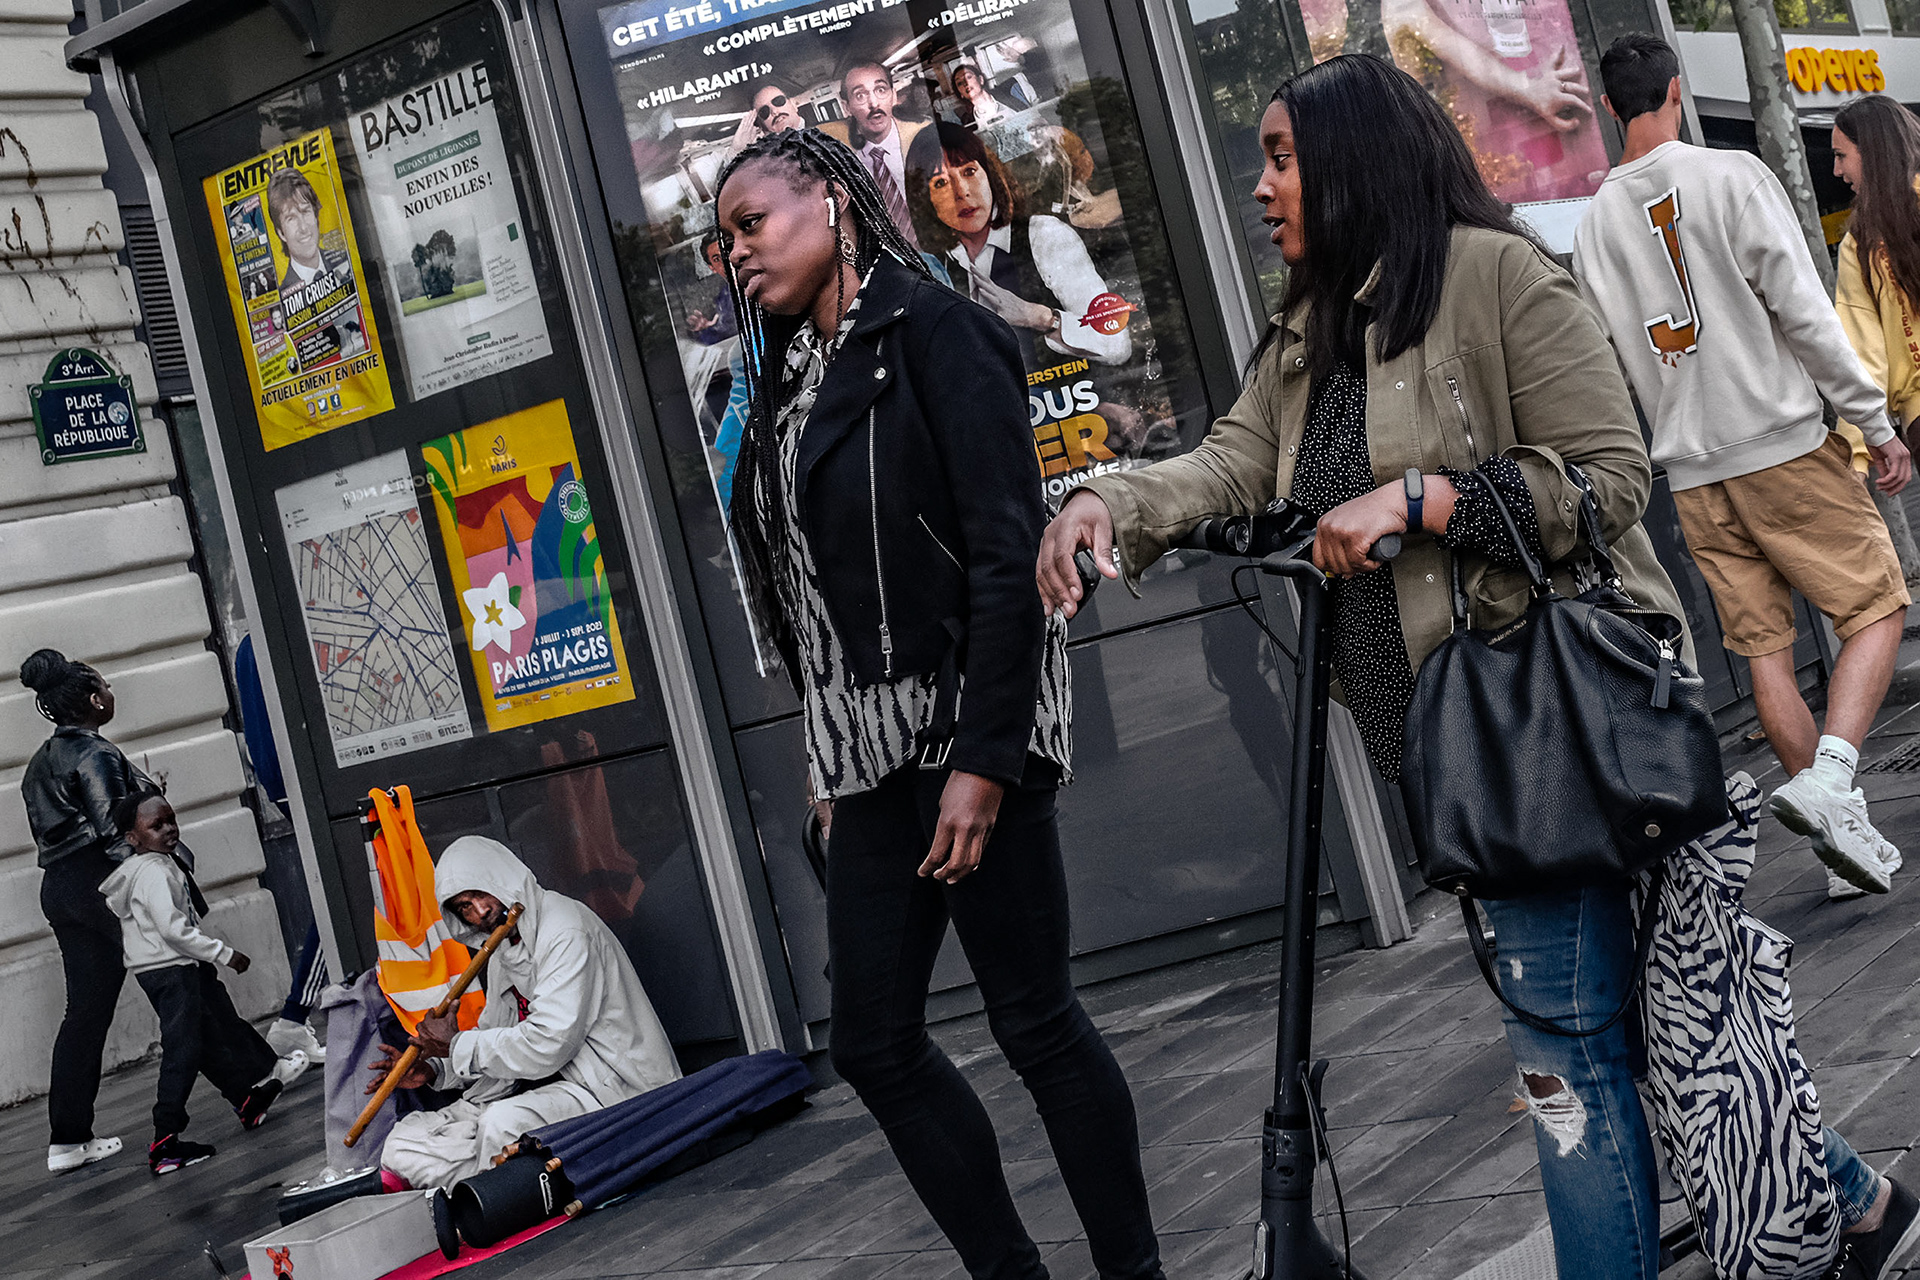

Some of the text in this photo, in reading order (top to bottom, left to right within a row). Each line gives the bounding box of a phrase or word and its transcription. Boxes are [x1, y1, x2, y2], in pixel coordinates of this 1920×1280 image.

[612, 16, 660, 46] CET
[665, 0, 721, 32] ÉTÉ,
[819, 20, 852, 34] NUMÉRO
[1002, 10, 1014, 18] FM
[620, 53, 666, 70] VENDÔME FILMS
[360, 64, 494, 152] BASTILLE
[224, 136, 321, 198] ENTREVUE
[396, 134, 480, 175] DUPONT DE LIGONNÈS
[406, 156, 480, 196] ENFIN DES
[283, 291, 304, 317] TOM
[306, 273, 337, 304] CRUISE
[287, 306, 312, 330] MISSION
[261, 371, 332, 408] ACTUELLEMENT
[336, 364, 350, 382] EN
[350, 354, 380, 376] VENTE
[1027, 358, 1090, 386] ERSTEIN
[65, 394, 105, 412] PLACE
[69, 410, 108, 428] DE LA
[54, 426, 130, 448] RÉPUBLIQUE
[491, 458, 517, 474] PARIS
[586, 620, 603, 634] 2023
[492, 635, 608, 684] PARIS PLAGES
